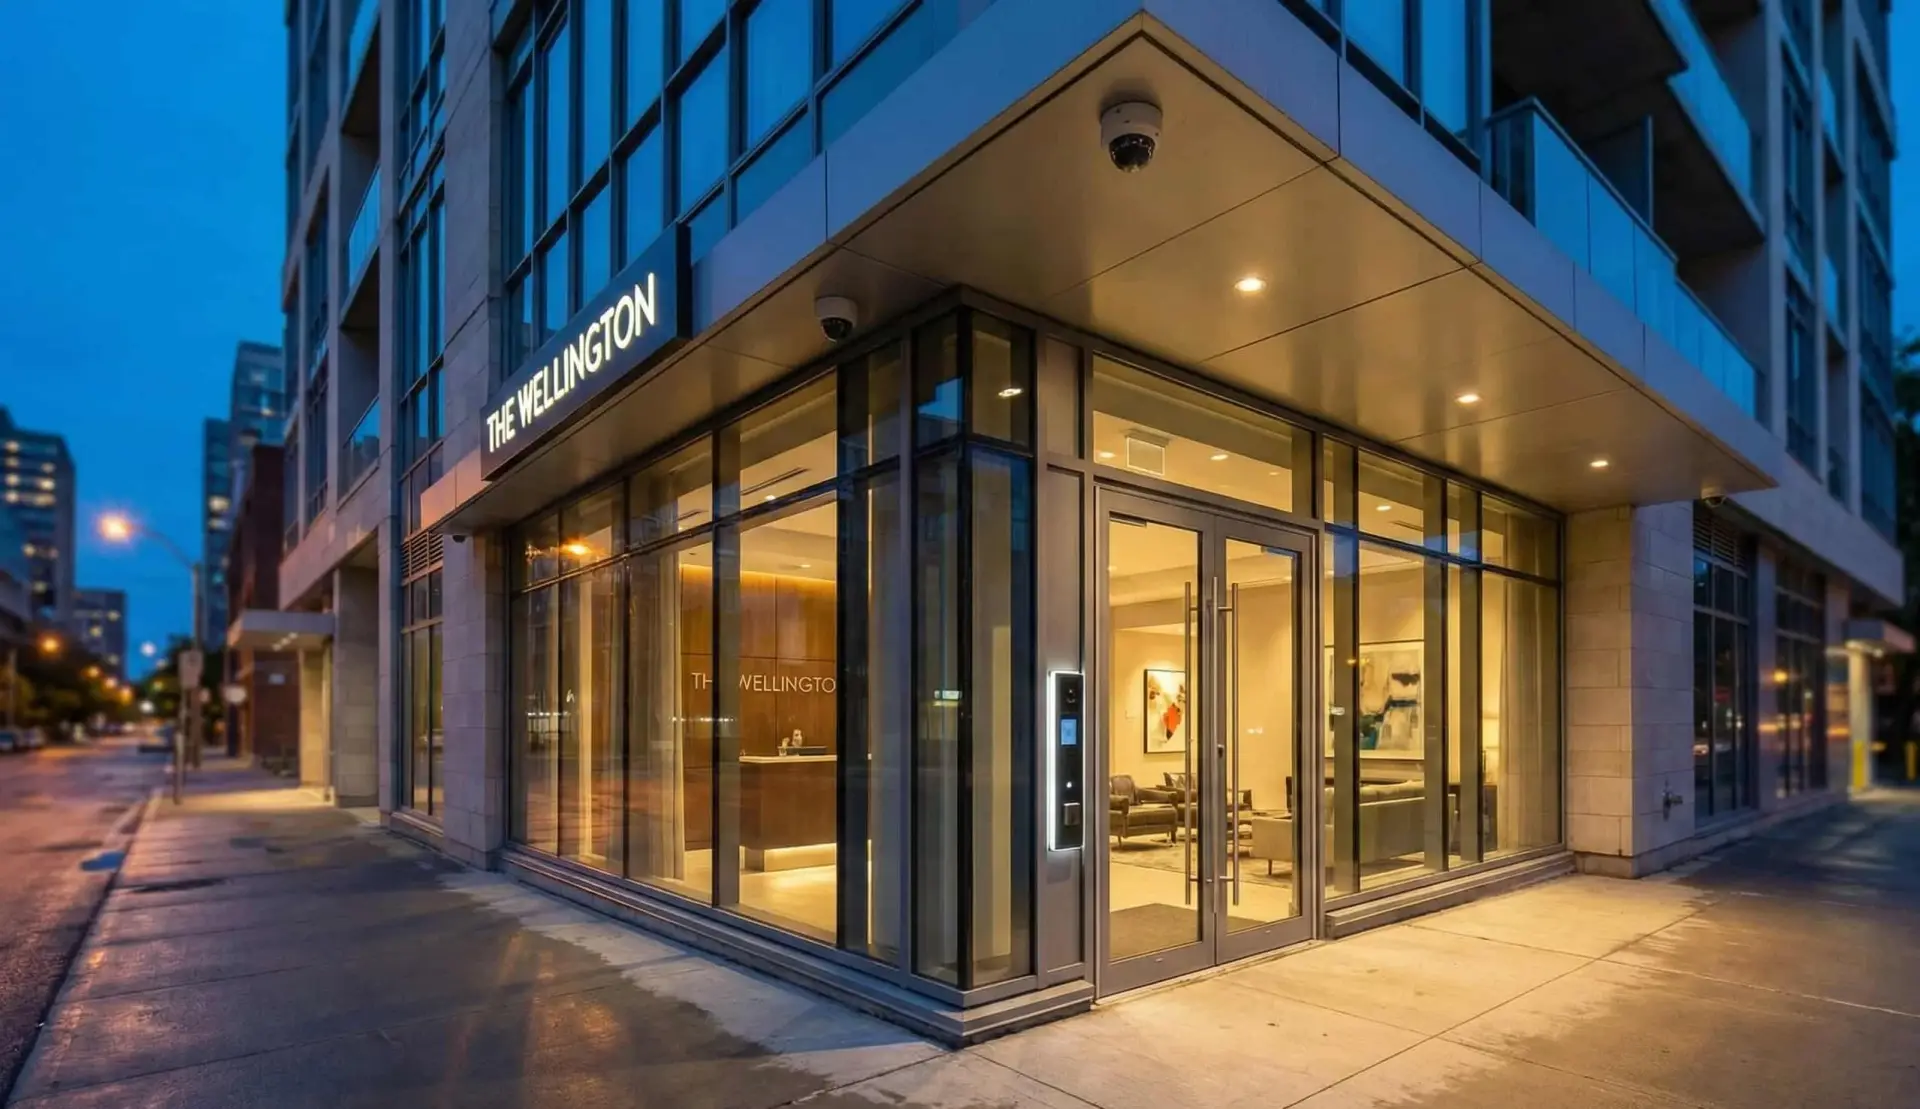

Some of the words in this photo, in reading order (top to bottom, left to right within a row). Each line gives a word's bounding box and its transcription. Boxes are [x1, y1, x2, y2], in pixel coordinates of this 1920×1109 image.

[487, 396, 516, 452] THE
[518, 272, 657, 428] WELLINGTON
[692, 672, 713, 690] TH
[739, 674, 836, 693] WELLINGTO
